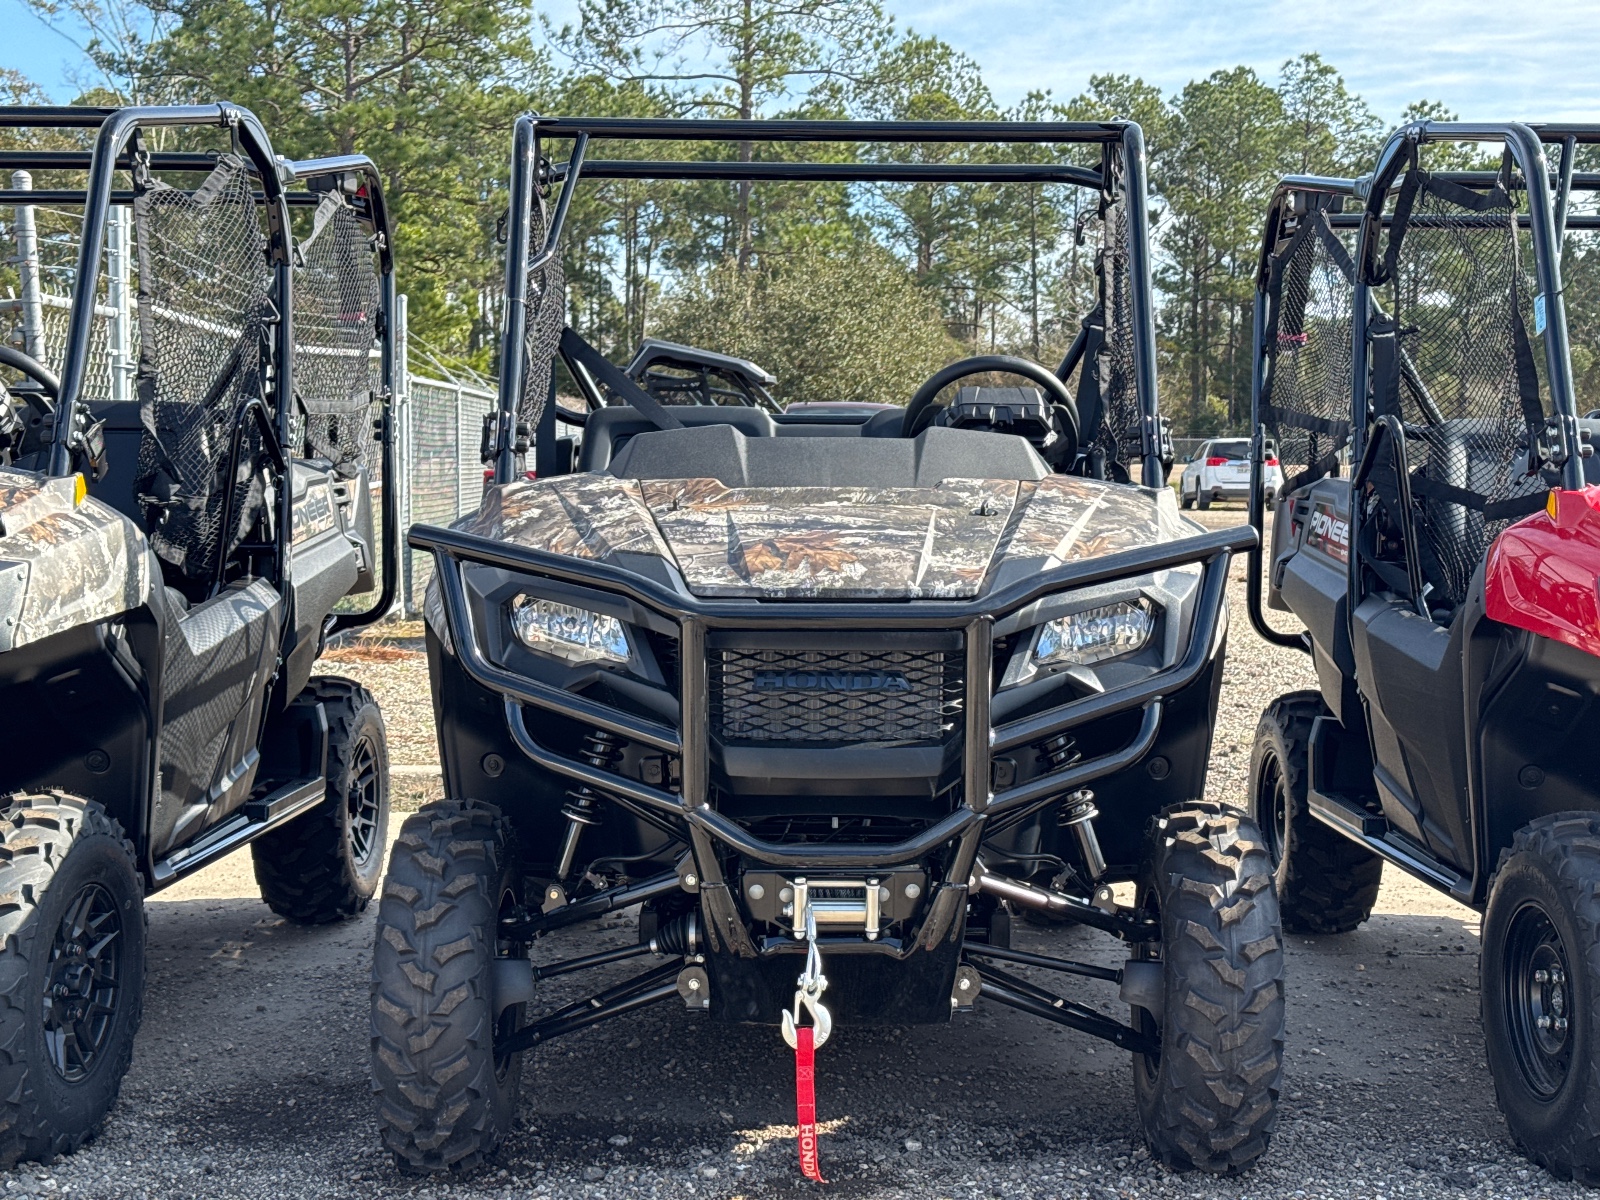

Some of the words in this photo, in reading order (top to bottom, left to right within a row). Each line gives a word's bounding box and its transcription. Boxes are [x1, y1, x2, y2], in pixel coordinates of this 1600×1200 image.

[292, 495, 331, 528] ONEER
[1310, 511, 1349, 546] PIONEE
[754, 671, 913, 691] HONDA
[801, 1123, 816, 1177] HONDA
